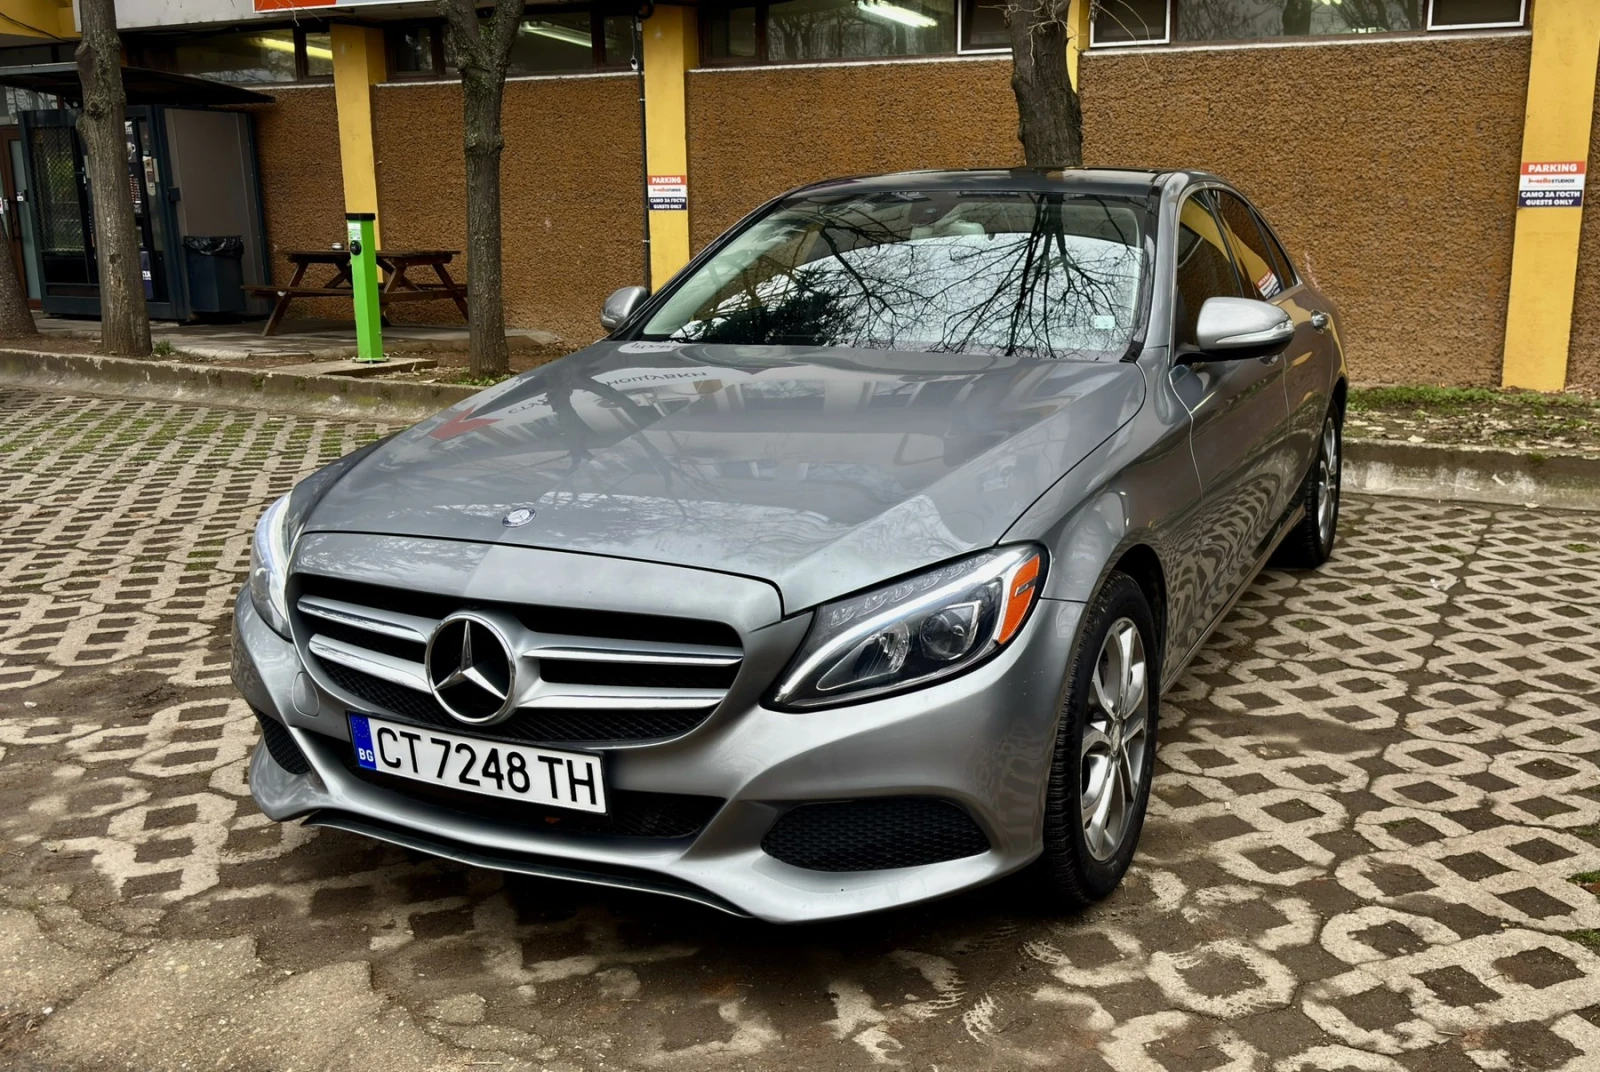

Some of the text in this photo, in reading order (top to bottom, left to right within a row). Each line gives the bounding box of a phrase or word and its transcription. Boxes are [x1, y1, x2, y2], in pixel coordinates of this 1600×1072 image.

[1528, 163, 1578, 173] PARKING
[359, 747, 375, 763] BG
[377, 727, 597, 805] CT 7248 TH
